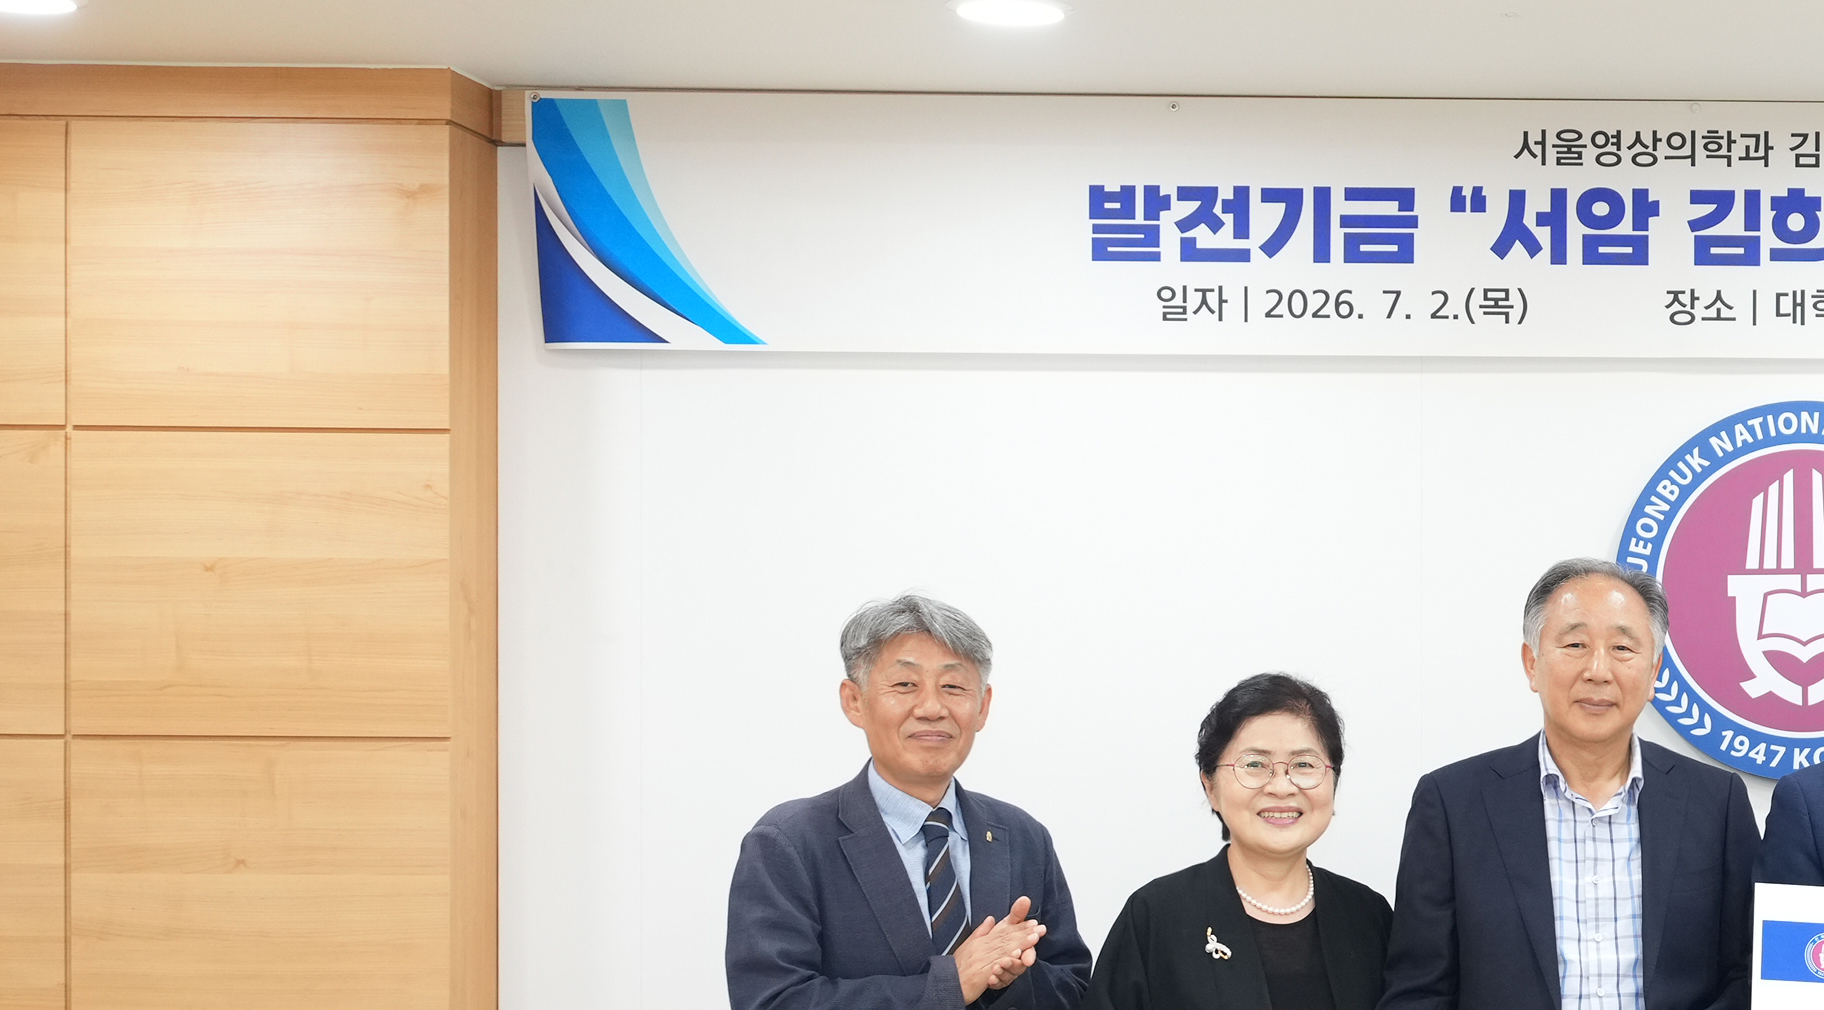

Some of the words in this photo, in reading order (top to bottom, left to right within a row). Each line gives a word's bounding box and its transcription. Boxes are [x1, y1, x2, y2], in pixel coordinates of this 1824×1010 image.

[1514, 129, 1774, 167] 서울영상의학과
[1089, 185, 1418, 263] 발전기금
[1450, 186, 1659, 265] “서암
[1157, 285, 1228, 321] 일자
[1265, 289, 1363, 319] 2026.
[1383, 290, 1411, 319] 7.
[1665, 289, 1736, 325] 장소
[1626, 446, 1710, 573] JEONBUK
[1718, 730, 1787, 770] 1947
